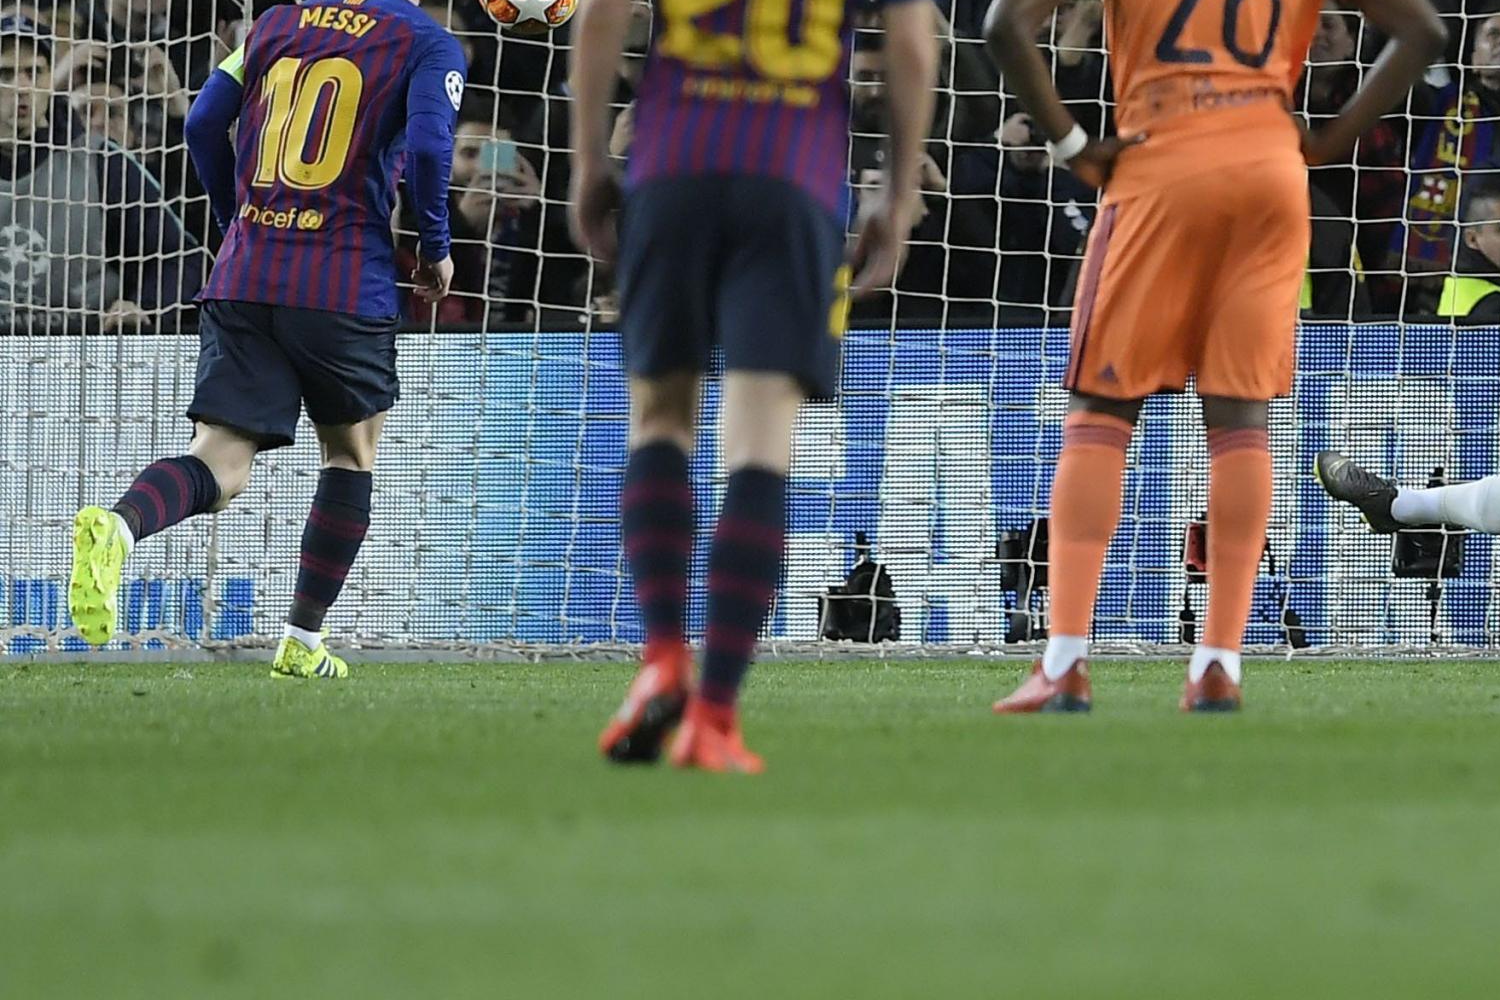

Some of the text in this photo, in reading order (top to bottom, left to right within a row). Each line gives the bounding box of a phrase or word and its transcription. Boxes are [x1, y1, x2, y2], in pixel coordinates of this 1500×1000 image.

[299, 6, 377, 39] MESSI
[251, 56, 364, 191] 10
[239, 203, 298, 230] unicef
